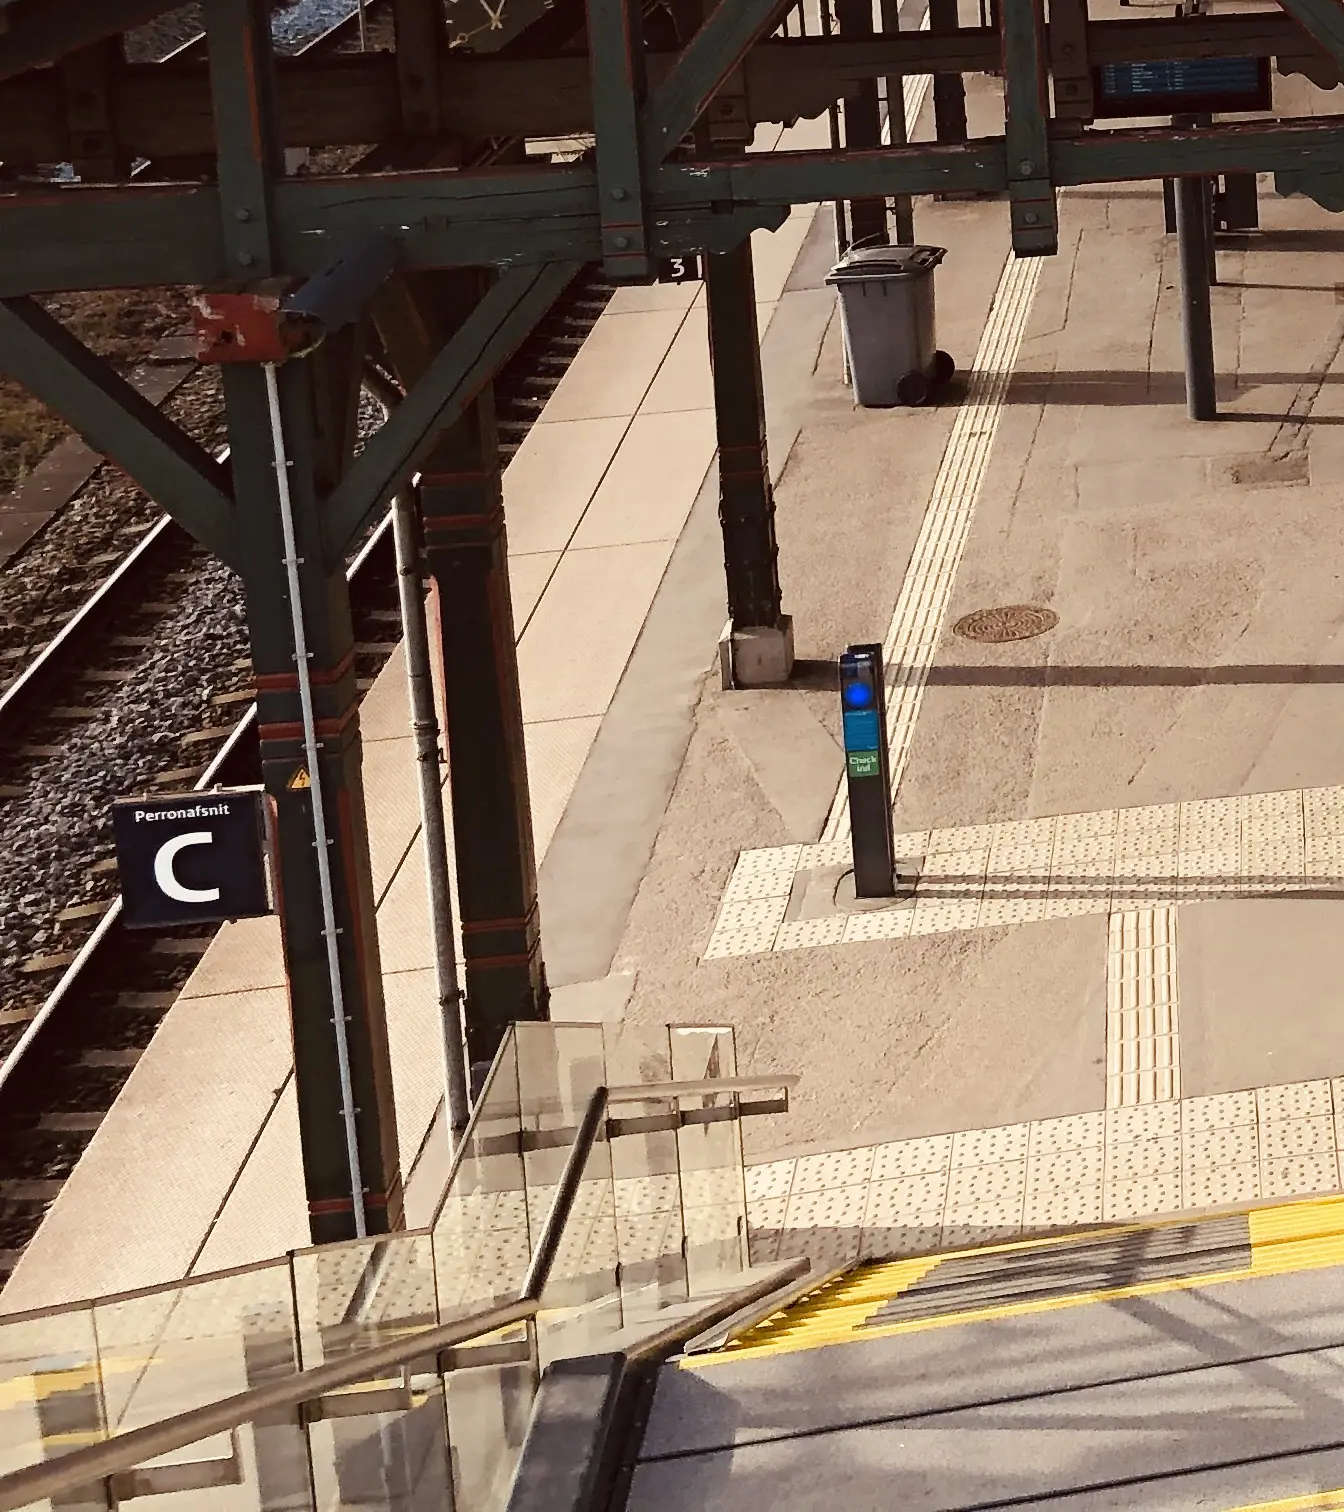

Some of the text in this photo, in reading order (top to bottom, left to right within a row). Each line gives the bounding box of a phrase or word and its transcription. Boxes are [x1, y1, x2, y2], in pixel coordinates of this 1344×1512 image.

[671, 258, 685, 278] 3
[849, 755, 877, 765] Check
[134, 803, 231, 823] Perronafsnit
[154, 831, 220, 903] C
